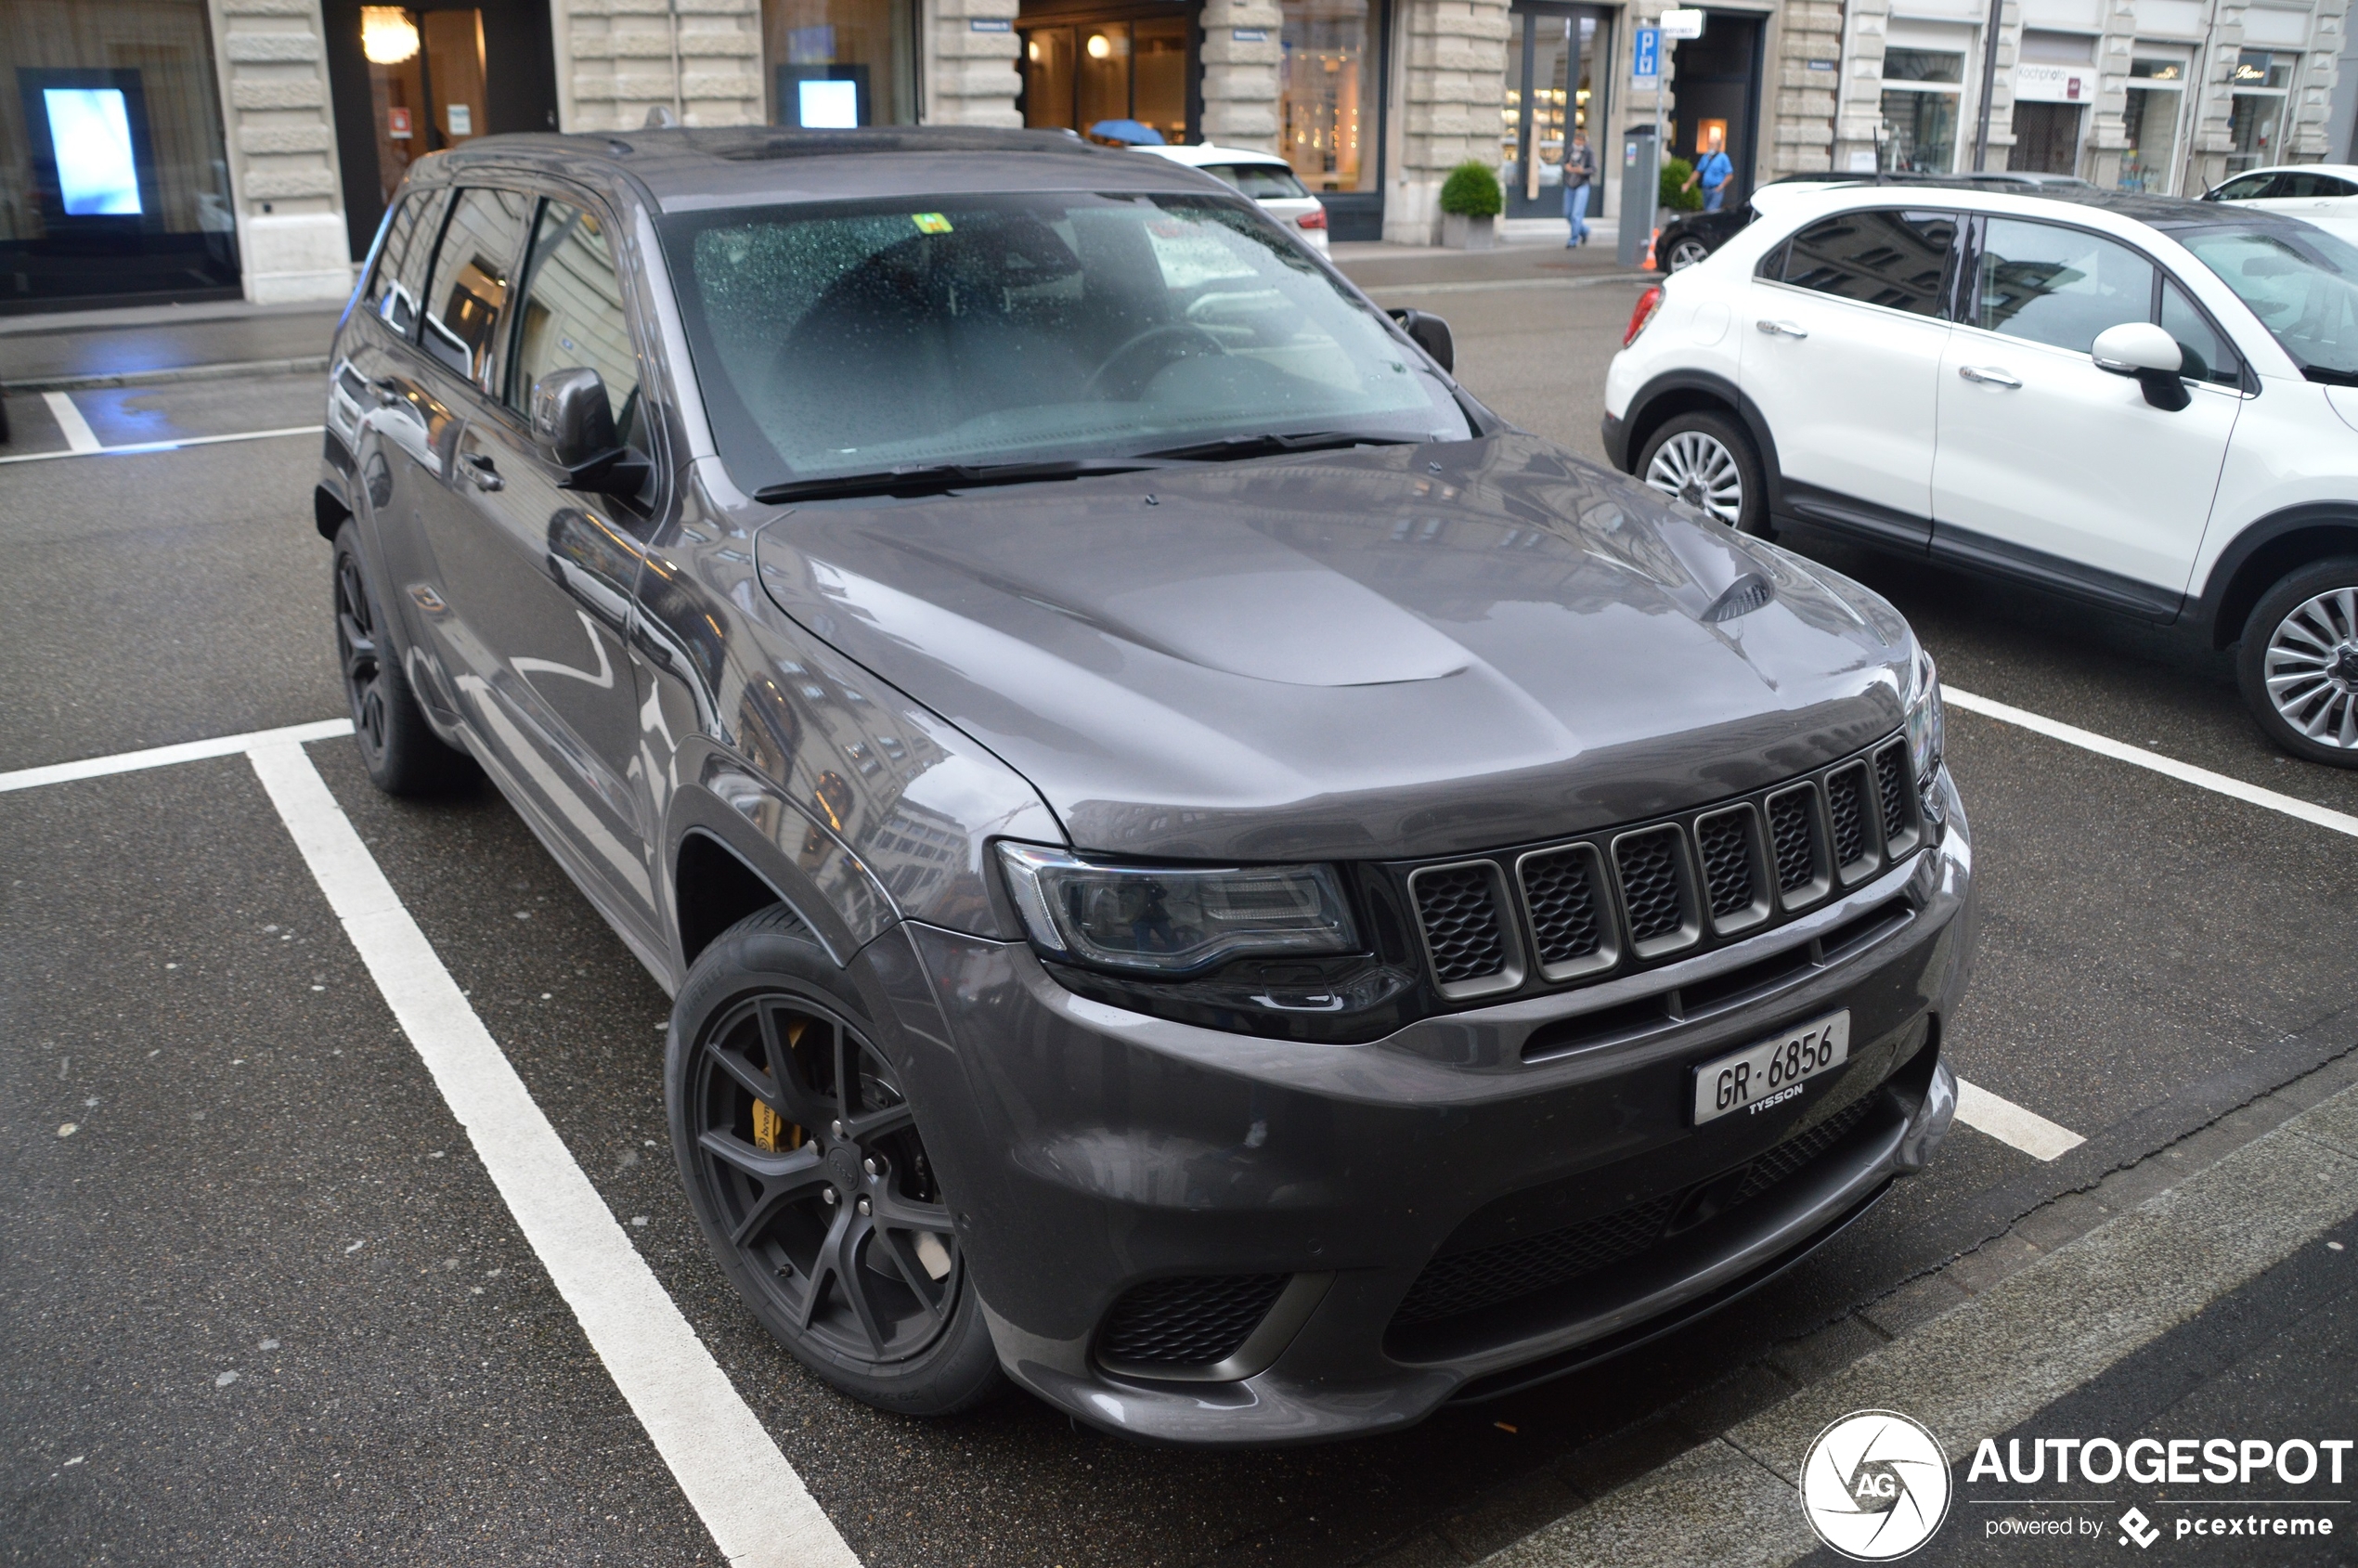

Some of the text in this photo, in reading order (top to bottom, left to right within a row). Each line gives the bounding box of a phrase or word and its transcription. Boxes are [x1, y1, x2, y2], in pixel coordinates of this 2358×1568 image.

[1642, 32, 1654, 57] P
[2017, 65, 2066, 82] Kochphoto
[1749, 1083, 1804, 1115] TYSSON
[760, 1106, 771, 1137] brem
